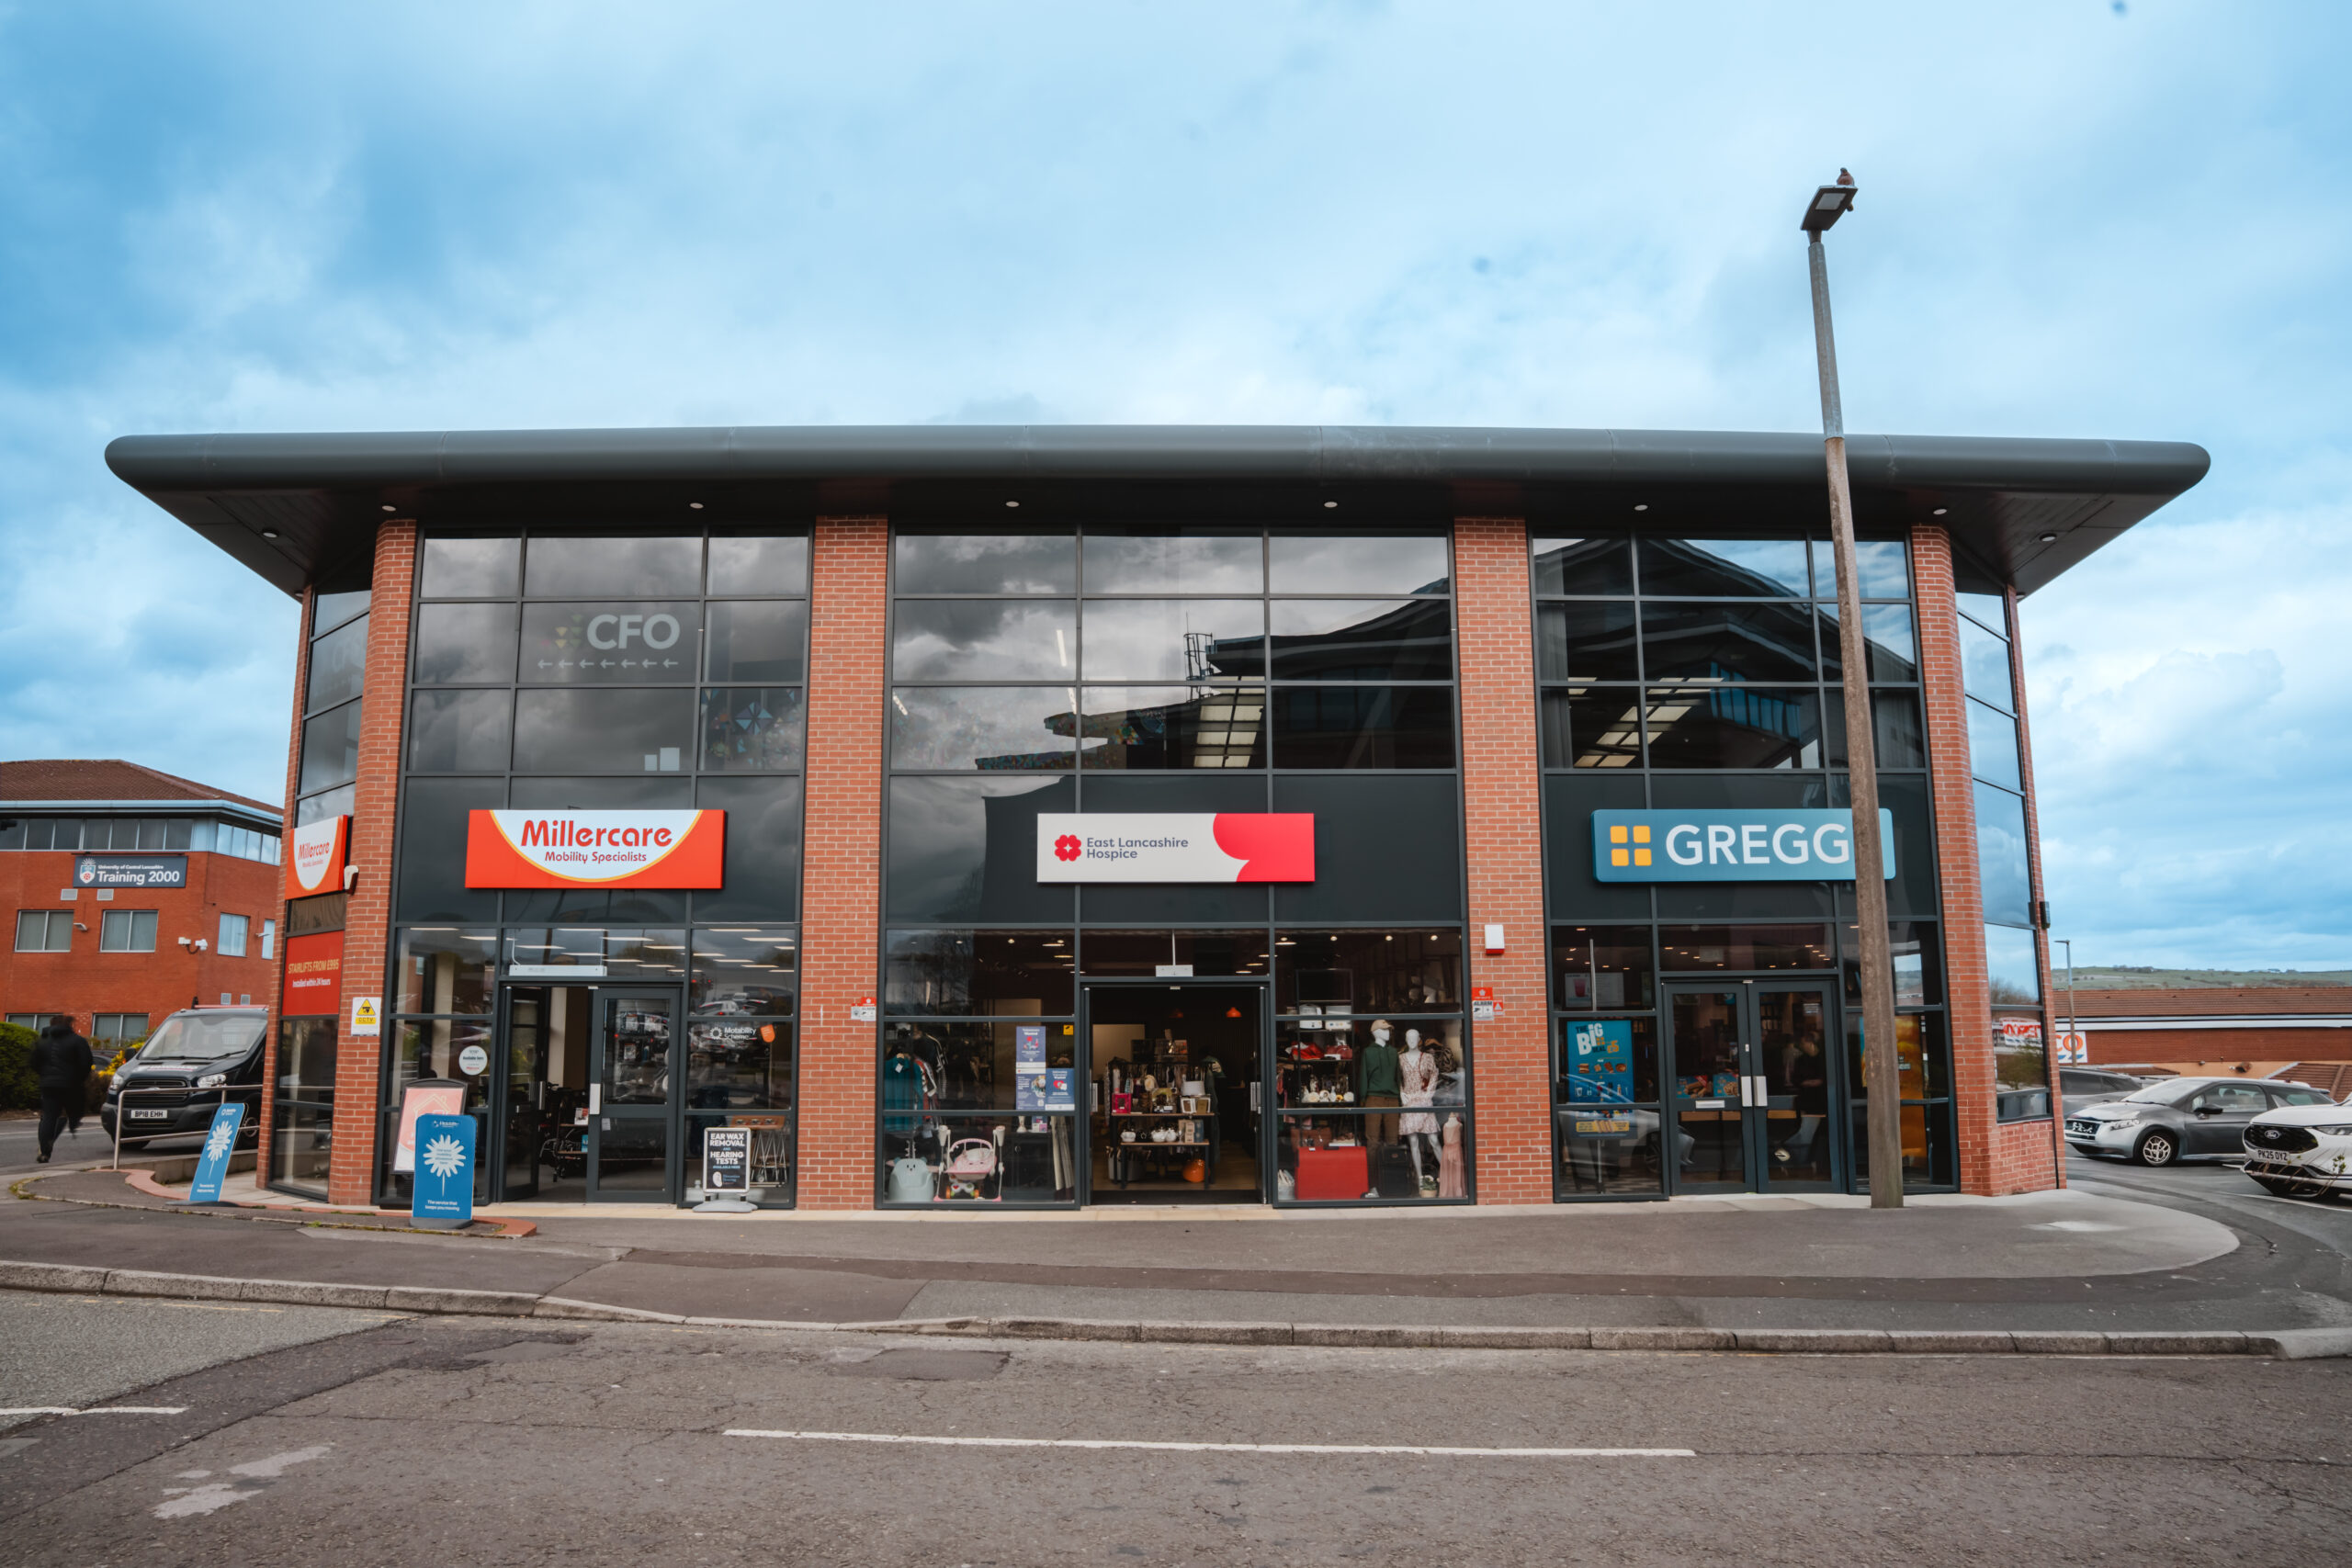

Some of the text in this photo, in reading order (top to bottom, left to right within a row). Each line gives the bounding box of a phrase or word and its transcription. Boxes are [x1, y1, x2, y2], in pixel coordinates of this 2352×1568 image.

[586, 614, 681, 649] CFO
[521, 819, 673, 847] Millercare
[1087, 837, 1189, 848] East Lancashire
[1666, 823, 1850, 865] GREGG
[545, 852, 648, 865] Mobility Specialists
[1087, 848, 1138, 862] Hospice
[97, 871, 180, 886] Training 2000
[312, 960, 327, 972] FROM
[724, 1027, 757, 1035] Motability
[2257, 1149, 2274, 1159] PK25
